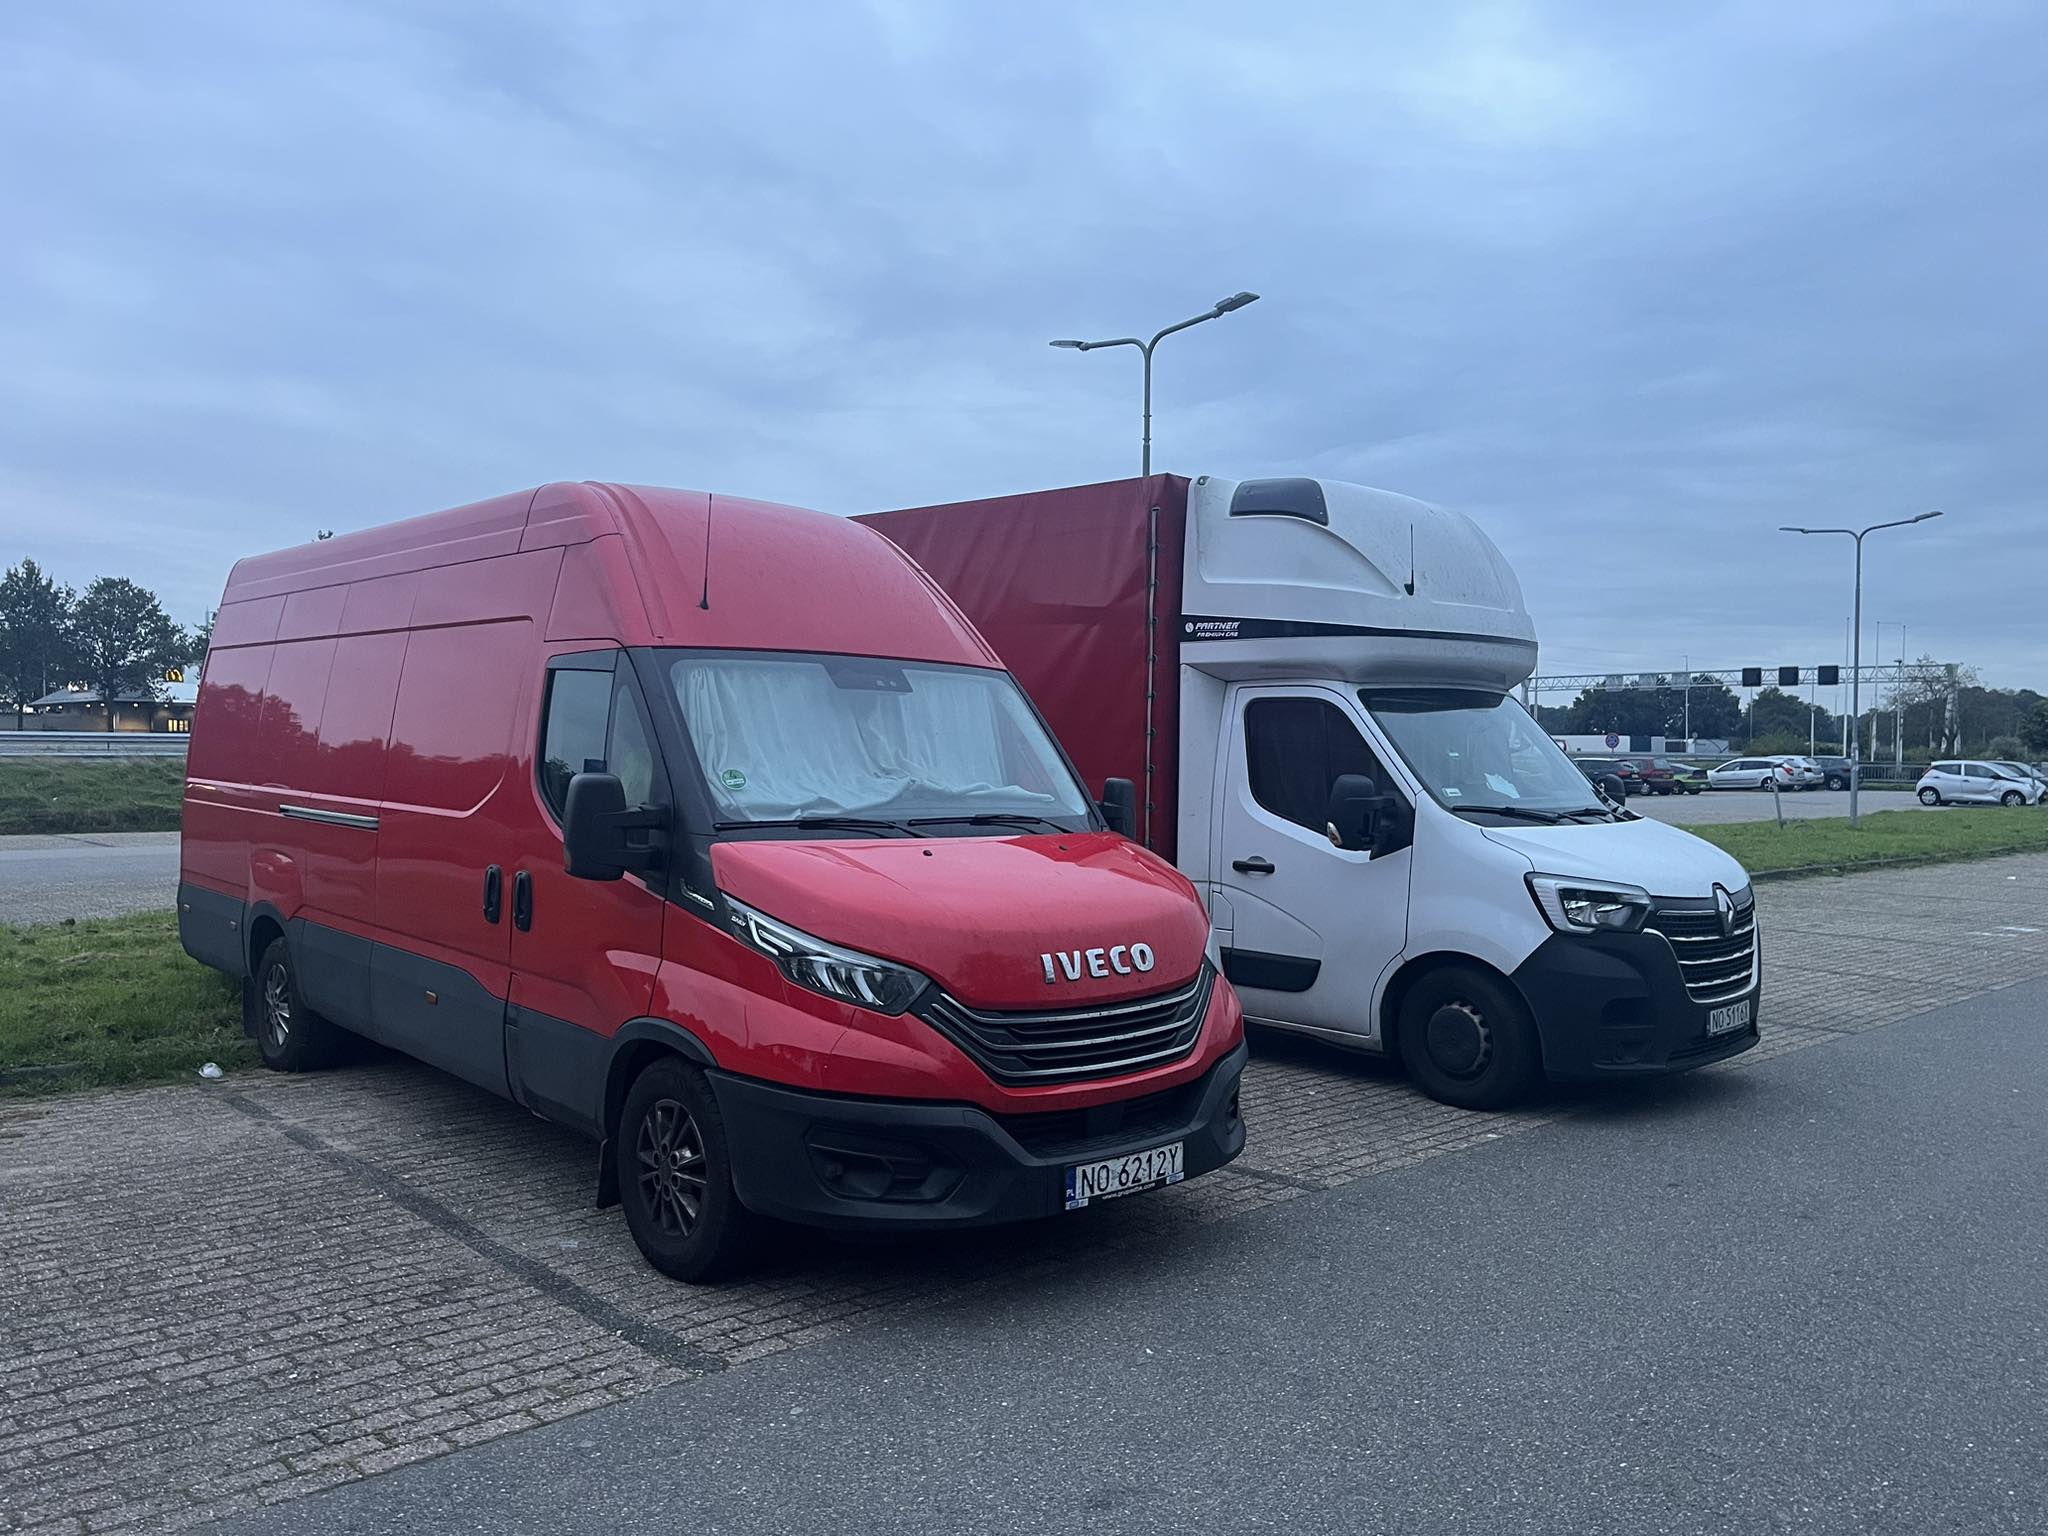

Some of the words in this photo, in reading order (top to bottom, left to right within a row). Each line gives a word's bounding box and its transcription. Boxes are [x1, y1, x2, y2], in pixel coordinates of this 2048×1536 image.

[1195, 621, 1240, 630] PARTNER
[1041, 943, 1155, 983] IVECO
[1712, 1010, 1724, 1031] NO
[1081, 1164, 1109, 1197] NO
[1119, 1146, 1178, 1187] 6212Y
